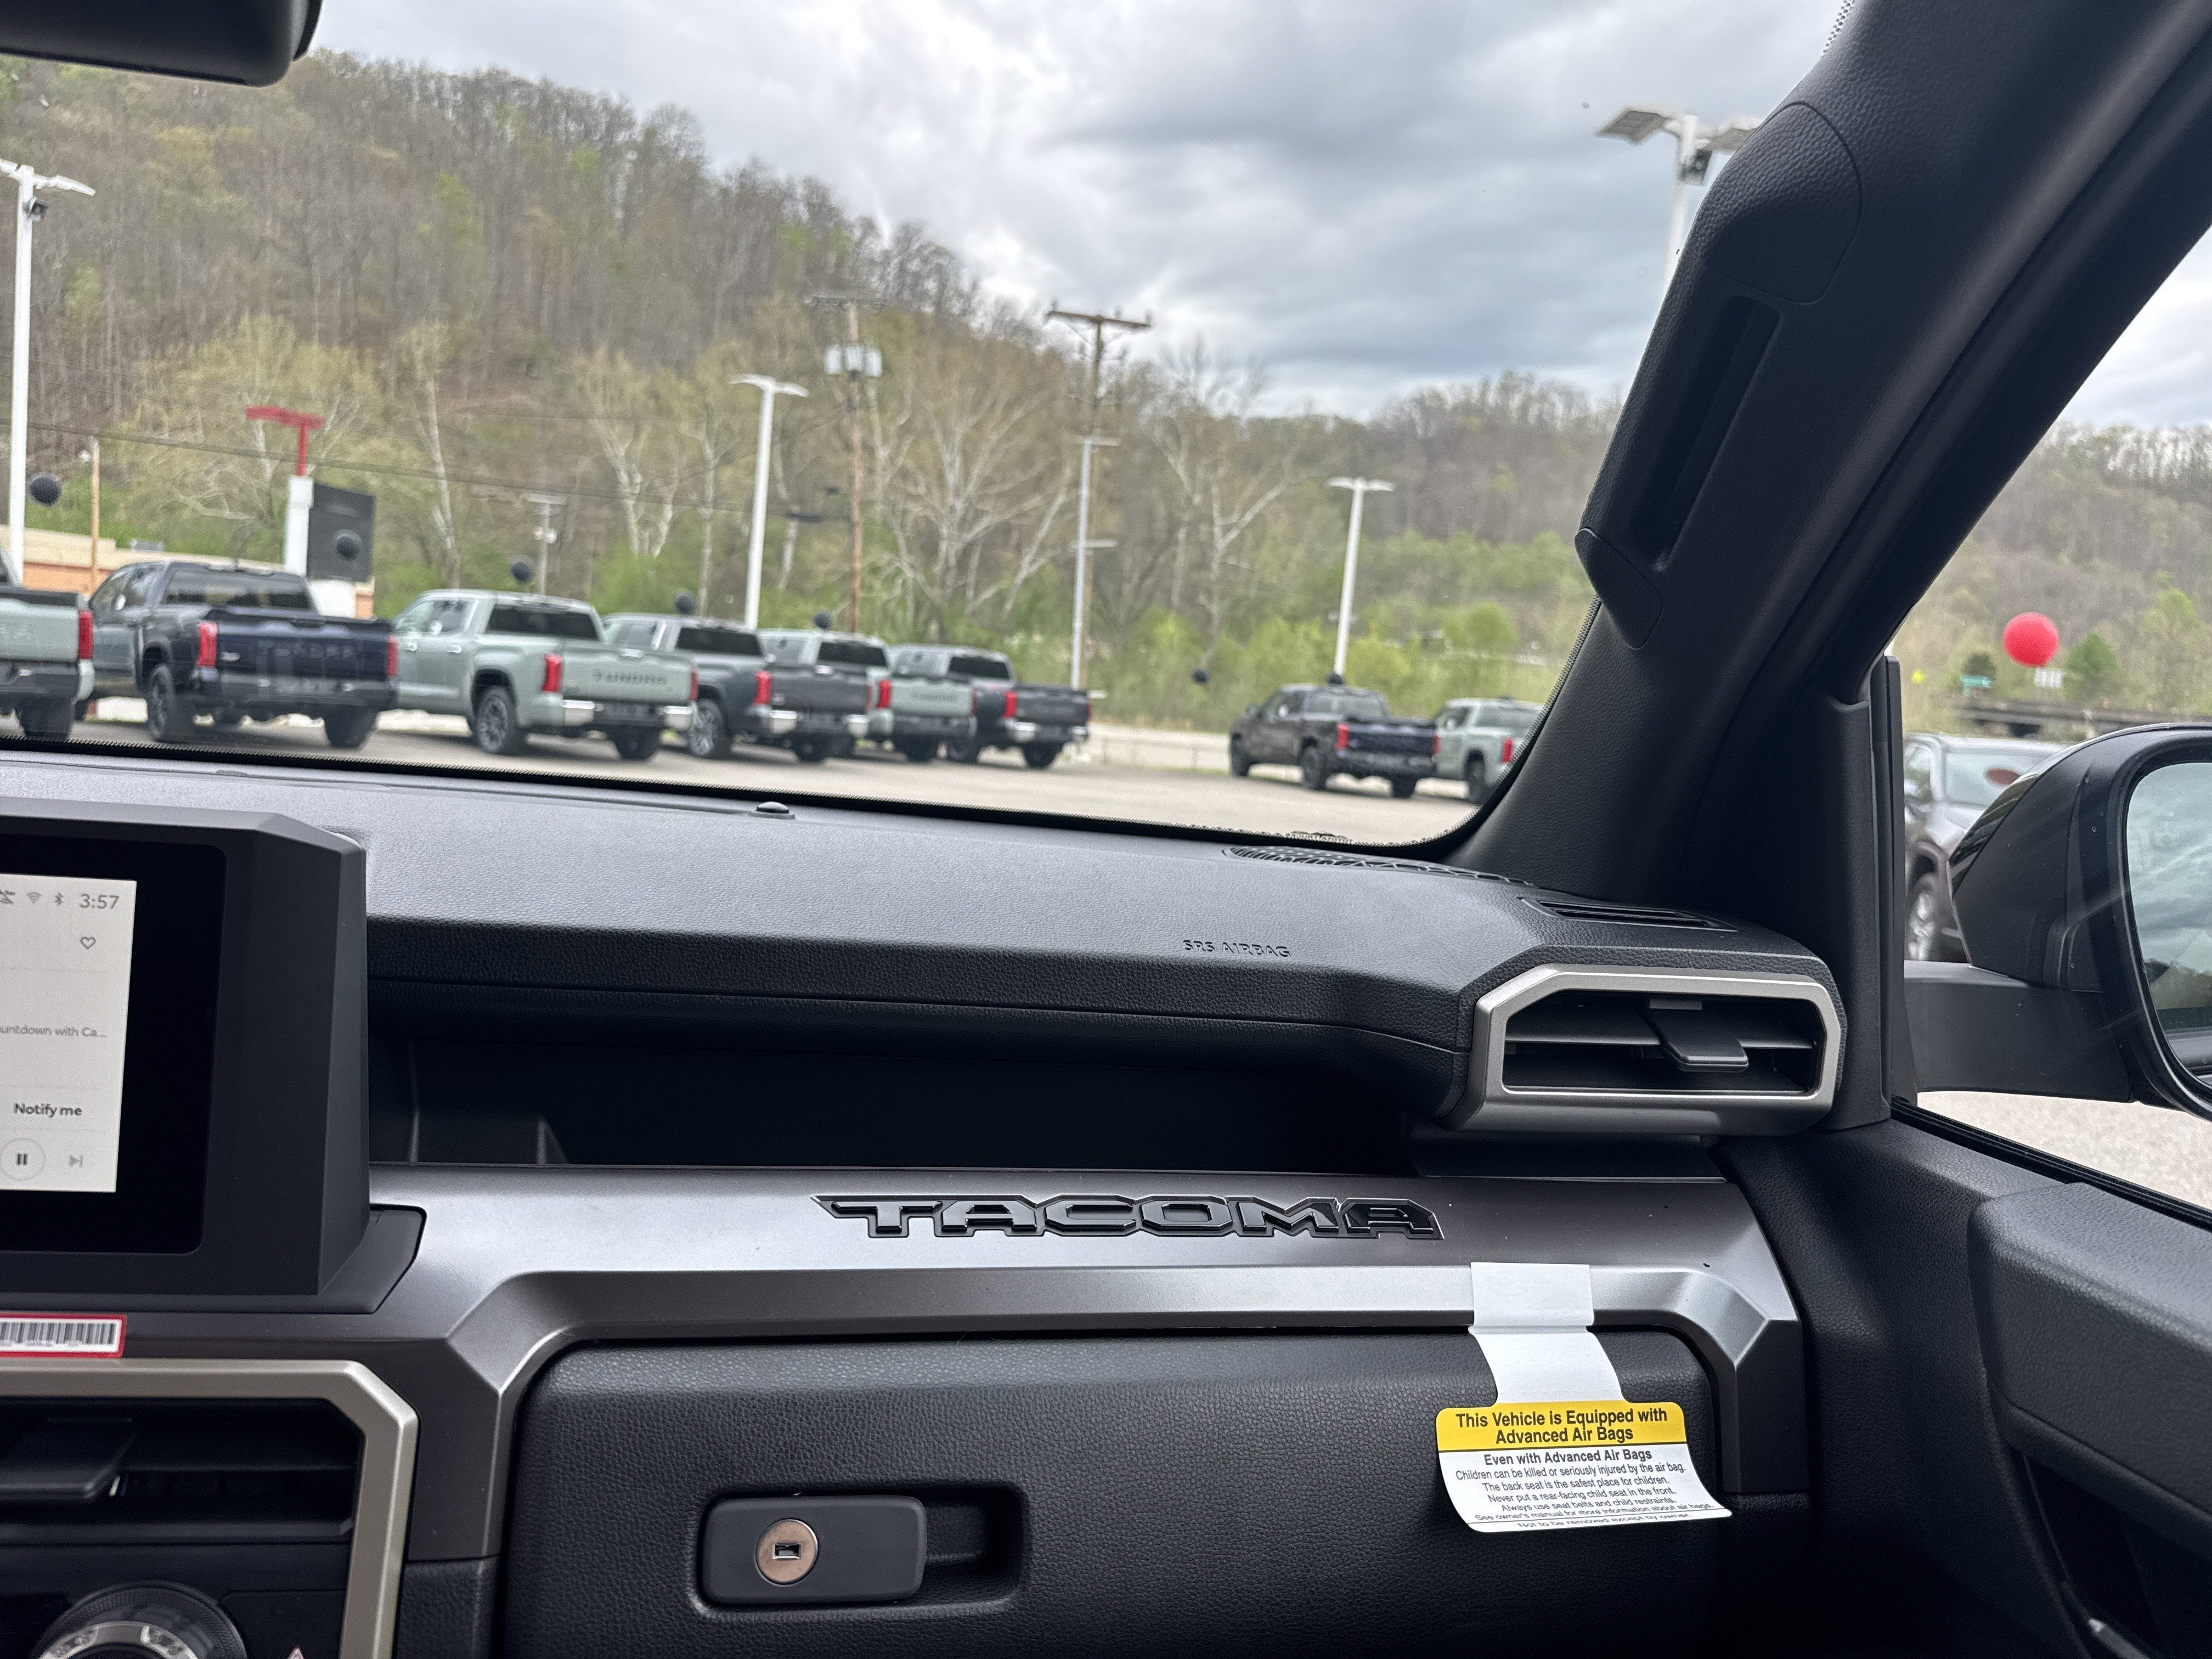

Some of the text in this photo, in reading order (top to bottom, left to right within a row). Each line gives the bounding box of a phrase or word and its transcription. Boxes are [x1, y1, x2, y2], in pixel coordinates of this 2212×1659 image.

[80, 893, 120, 909] 3:57
[1183, 940, 1291, 957] SRS AIRBAG
[55, 1026, 79, 1036] with
[14, 1103, 82, 1118] Notify me
[811, 1195, 1444, 1240] TACOMA
[1455, 1407, 1667, 1427] This Vehicle is Equipped with
[1496, 1426, 1633, 1444] Advanced Air Bags
[1484, 1449, 1652, 1465] Even with Advanced Air Bags
[1456, 1470, 1492, 1480] Children
[1494, 1470, 1510, 1479] can
[1511, 1468, 1523, 1478] be
[1524, 1467, 1547, 1477] killed
[1560, 1465, 1596, 1476] seriously
[1598, 1464, 1627, 1476] injured
[1627, 1464, 1638, 1475] by
[1639, 1463, 1653, 1472] the
[1655, 1463, 1665, 1472] air
[1667, 1462, 1686, 1473] bag.
[1482, 1476, 1670, 1491] The back seat is the safest place for children.
[1487, 1494, 1514, 1503] Never
[1516, 1493, 1531, 1503] put
[1539, 1491, 1587, 1500] rear-facing
[1587, 1489, 1607, 1498] child
[1652, 1487, 1676, 1495] front.
